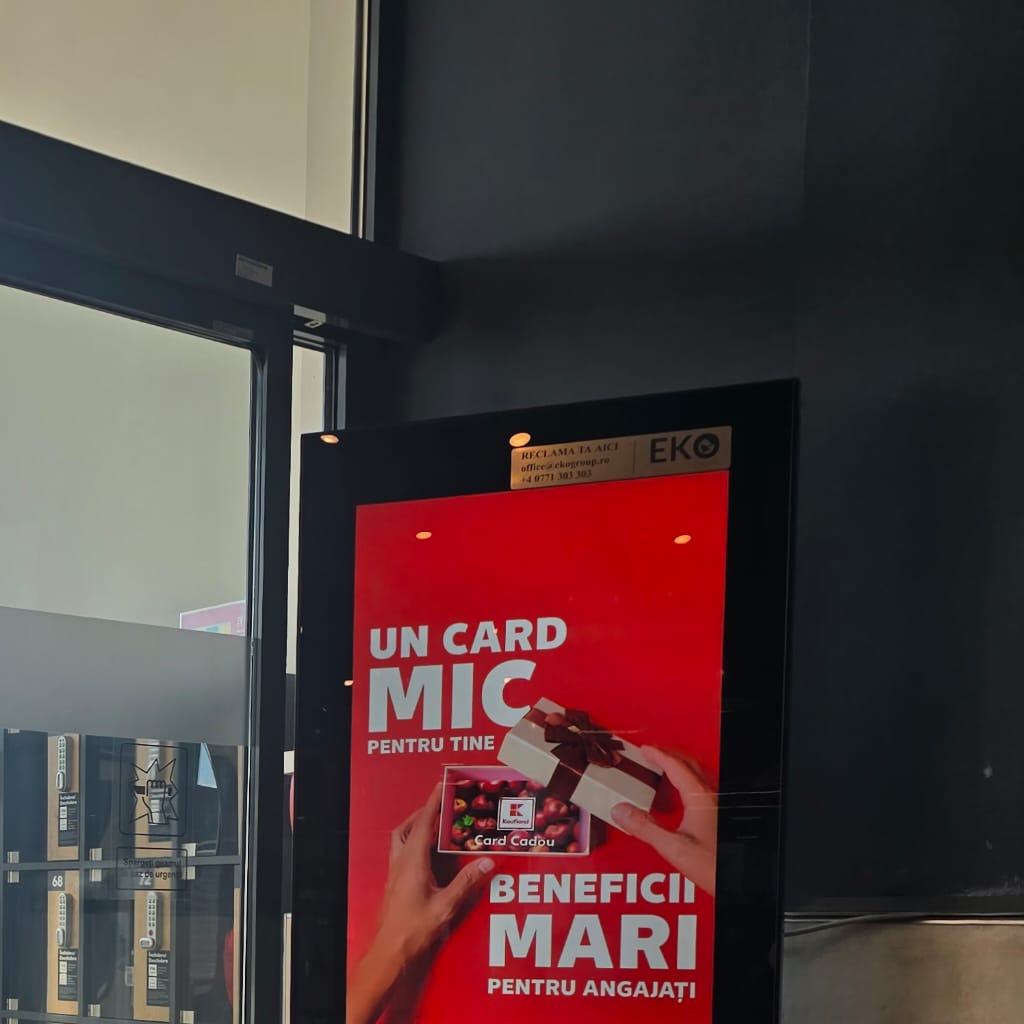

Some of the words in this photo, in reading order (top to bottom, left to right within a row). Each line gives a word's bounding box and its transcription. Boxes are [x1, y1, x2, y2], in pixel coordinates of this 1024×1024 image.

[521, 448, 575, 460] RECLAMA
[577, 445, 592, 455] TA
[595, 442, 619, 452] AICI
[649, 433, 720, 464] EKO
[521, 457, 611, 473] office@ekogroup.ro
[521, 474, 532, 484] +4
[534, 473, 555, 483] 0771
[557, 471, 574, 481] 303
[575, 469, 592, 479] 303
[369, 624, 429, 660] UN
[442, 617, 568, 655] CARD
[367, 659, 537, 733] MIC
[367, 737, 445, 755] PENTRU
[450, 735, 495, 752] TINE
[502, 817, 530, 825] Kaufland
[474, 834, 506, 846] Card
[510, 835, 555, 847] Cadou
[52, 875, 63, 887] 68
[489, 872, 696, 904] BENEFICII
[488, 913, 697, 970] MARI
[487, 977, 576, 997] PENTRU
[582, 978, 696, 1003] ANGAJAȚI
